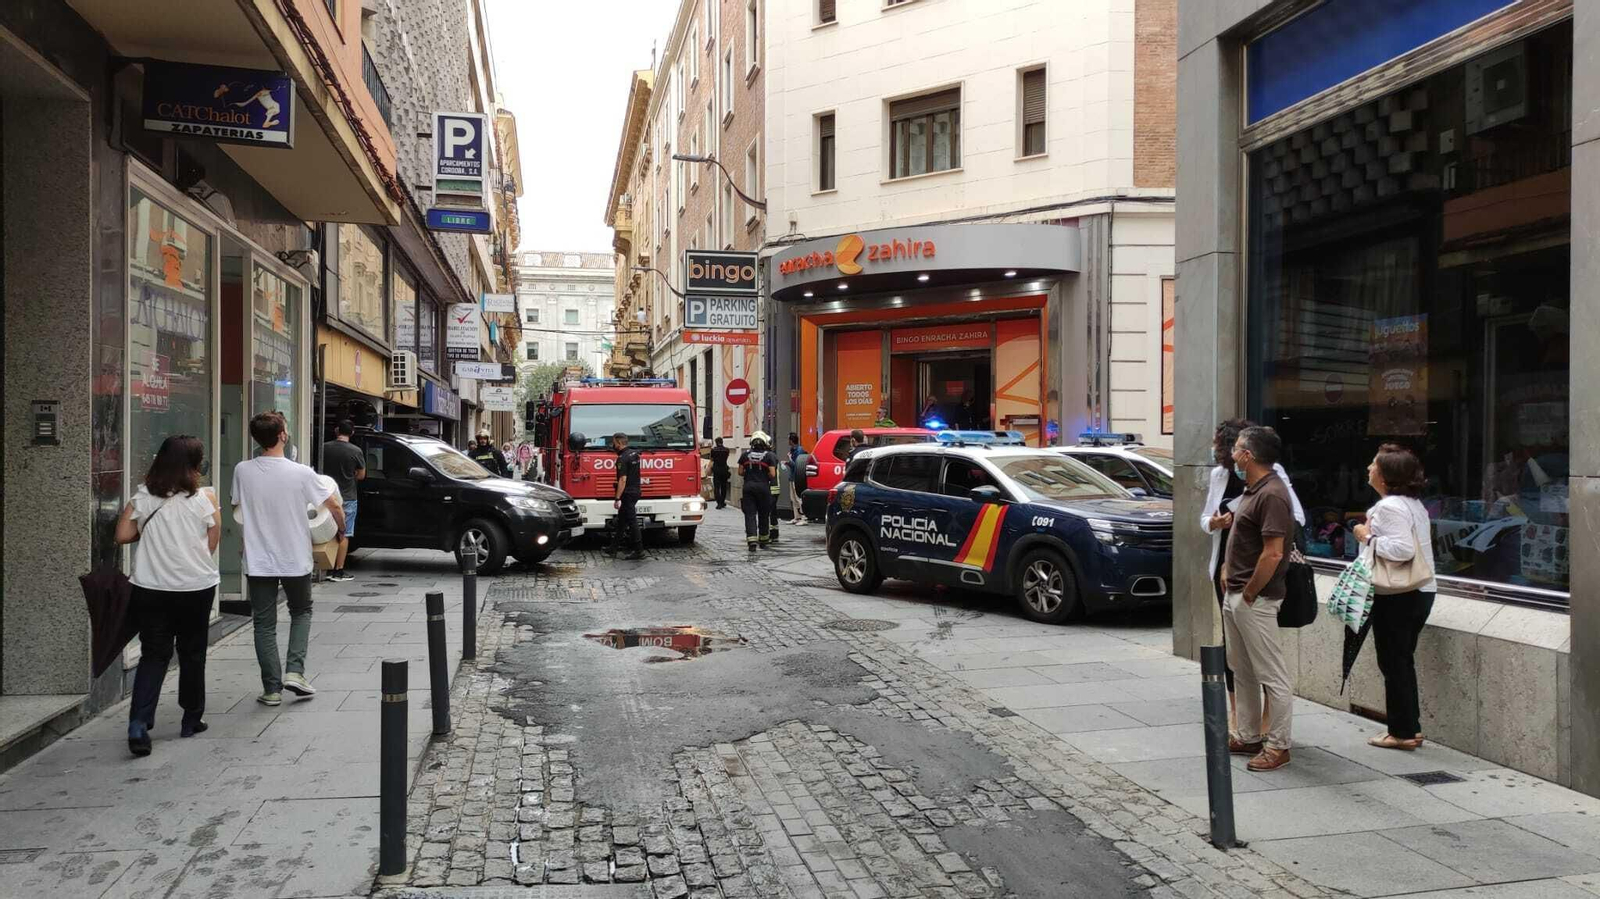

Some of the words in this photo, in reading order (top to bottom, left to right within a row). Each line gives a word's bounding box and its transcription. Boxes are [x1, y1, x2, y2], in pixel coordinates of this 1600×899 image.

[171, 123, 263, 140] ZAPATERIAS
[444, 119, 475, 158] P
[447, 216, 470, 225] LIBRE
[867, 238, 936, 261] zahira
[689, 259, 755, 283] bingo
[690, 300, 704, 322] P
[710, 298, 755, 312] PARKING
[709, 313, 755, 326] GRATUITO
[896, 335, 920, 344] BINGO
[921, 333, 957, 342] ENRACHA
[958, 331, 988, 340] ZAHIRA
[881, 515, 938, 532] POLICÍA
[1036, 517, 1054, 528] 091
[880, 527, 957, 547] NACIONAL
